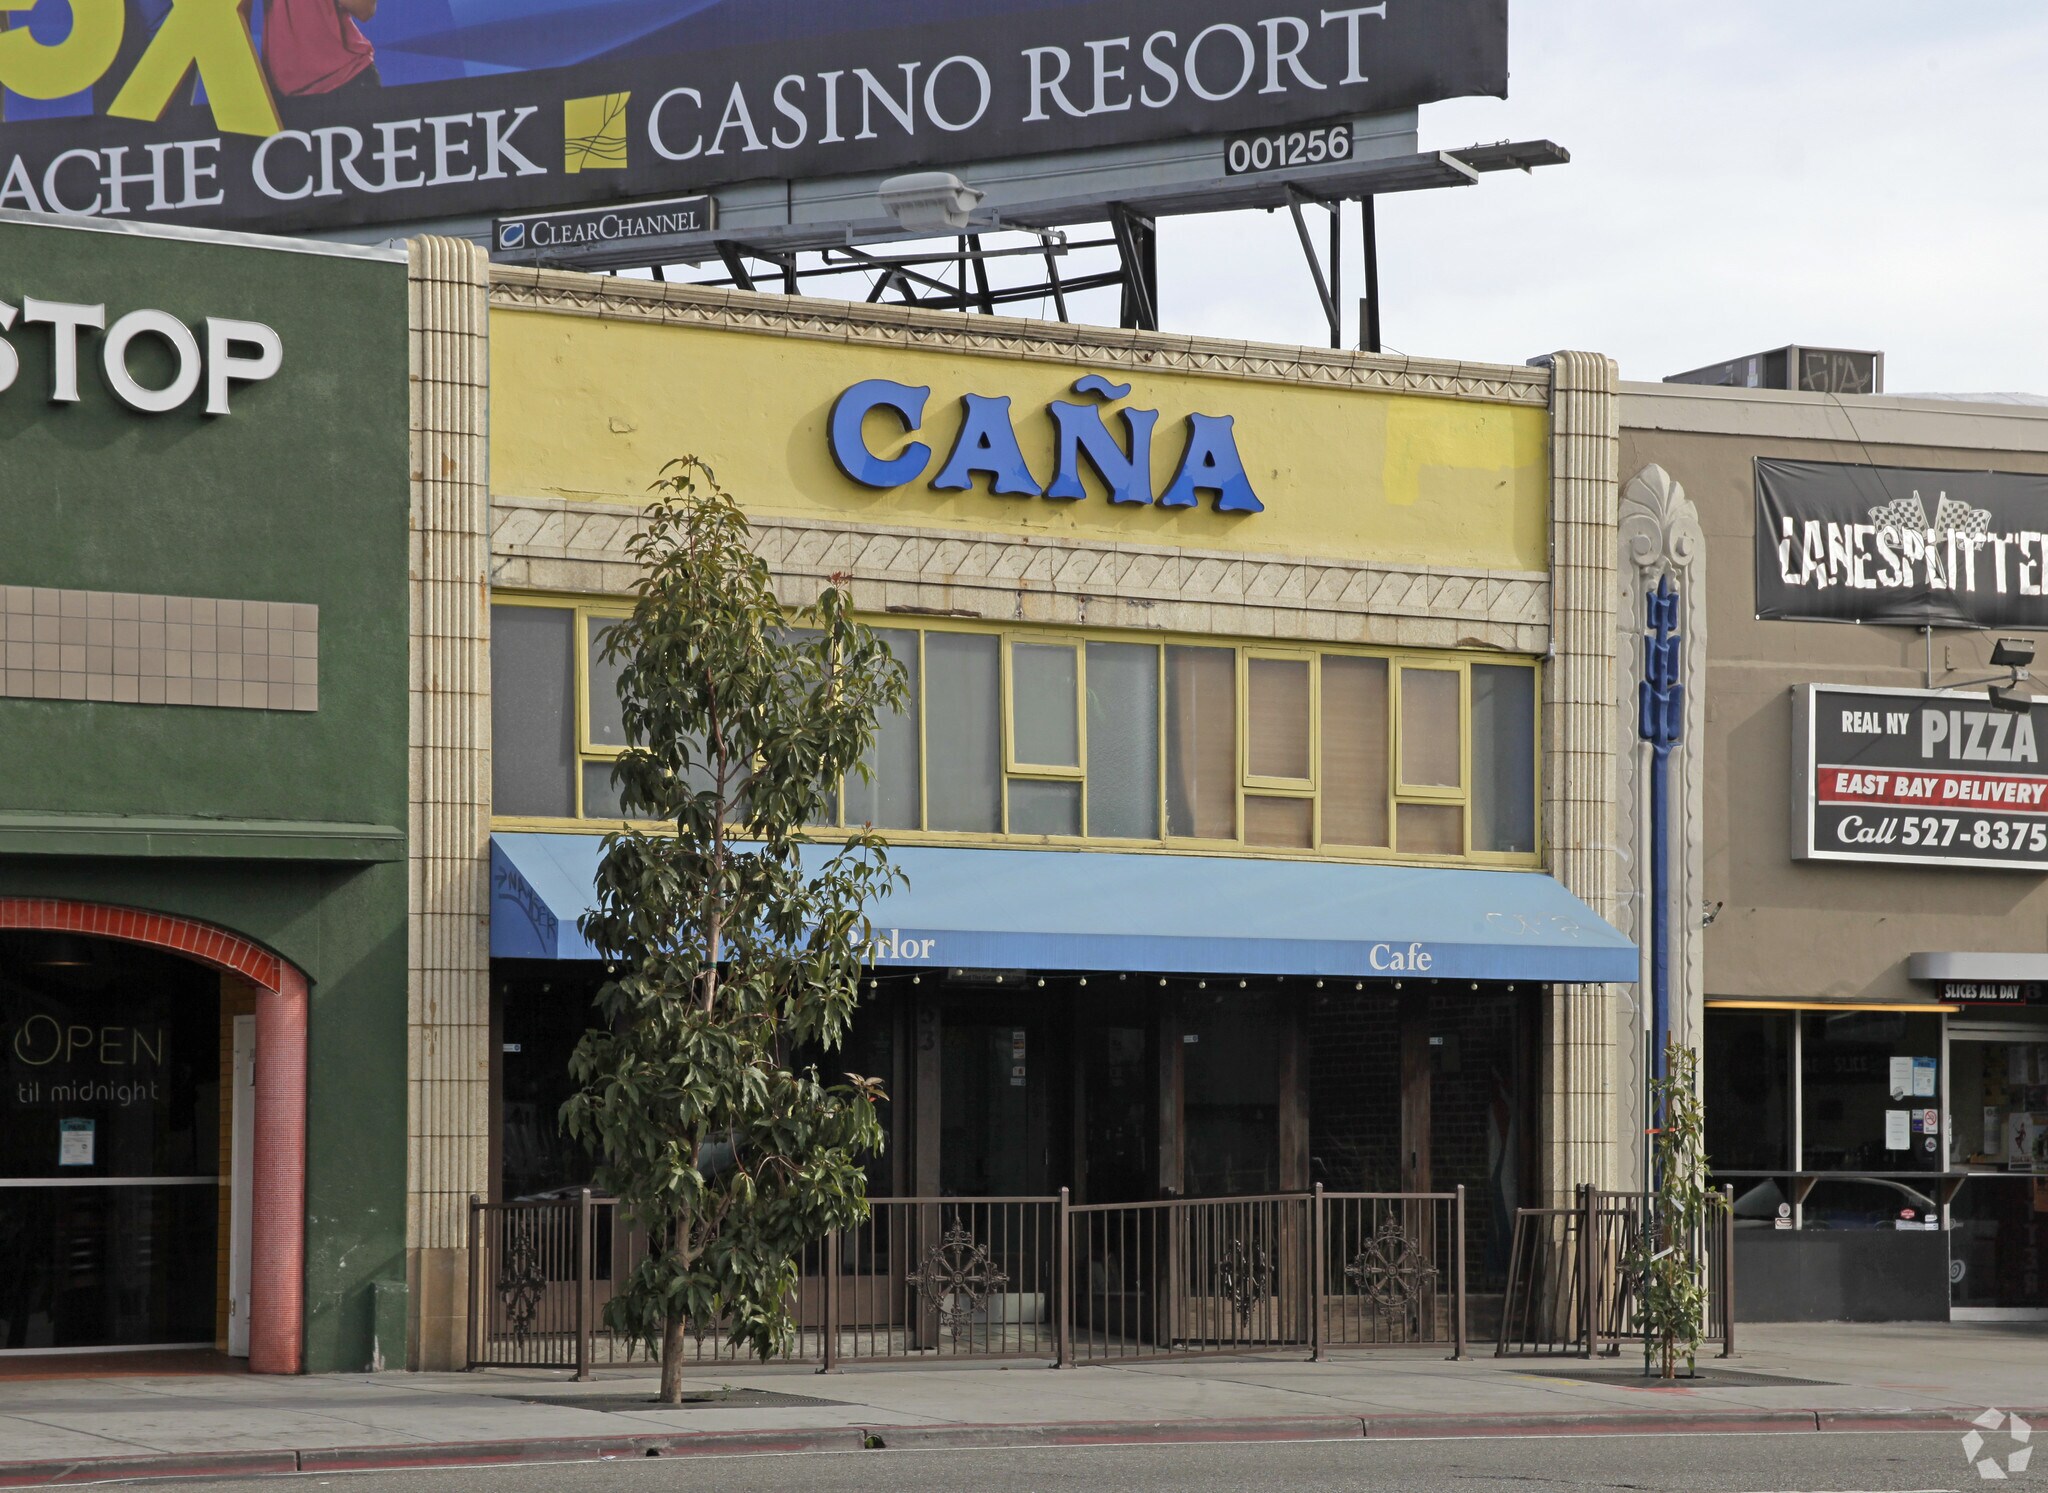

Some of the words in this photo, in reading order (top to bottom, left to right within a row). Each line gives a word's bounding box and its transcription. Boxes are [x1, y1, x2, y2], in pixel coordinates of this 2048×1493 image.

[252, 106, 546, 201] CREEK
[648, 55, 991, 161] CASINO
[1021, 1, 1387, 122] RESORT
[1228, 126, 1349, 173] 001256
[0, 295, 283, 415] TOP
[827, 374, 1265, 513] CAÑA
[1778, 516, 2048, 597] LANESPLITTE
[1842, 710, 1882, 734] REAL
[1886, 712, 1909, 735] NY
[1921, 709, 2039, 763] PIZZA
[1835, 772, 1889, 795] EAST
[1894, 776, 1939, 798] BAY
[1943, 779, 2047, 804] DELIVERY
[1837, 815, 1899, 844] Call
[1902, 816, 2048, 852] 527-8375
[1369, 942, 1433, 971] Cafe
[1944, 983, 1978, 999] SLICES
[1978, 984, 1998, 999] ALL
[1999, 985, 2020, 1000] DAY
[14, 1014, 163, 1066] OPEN
[18, 1081, 39, 1103] til
[51, 1080, 160, 1107] midnight
